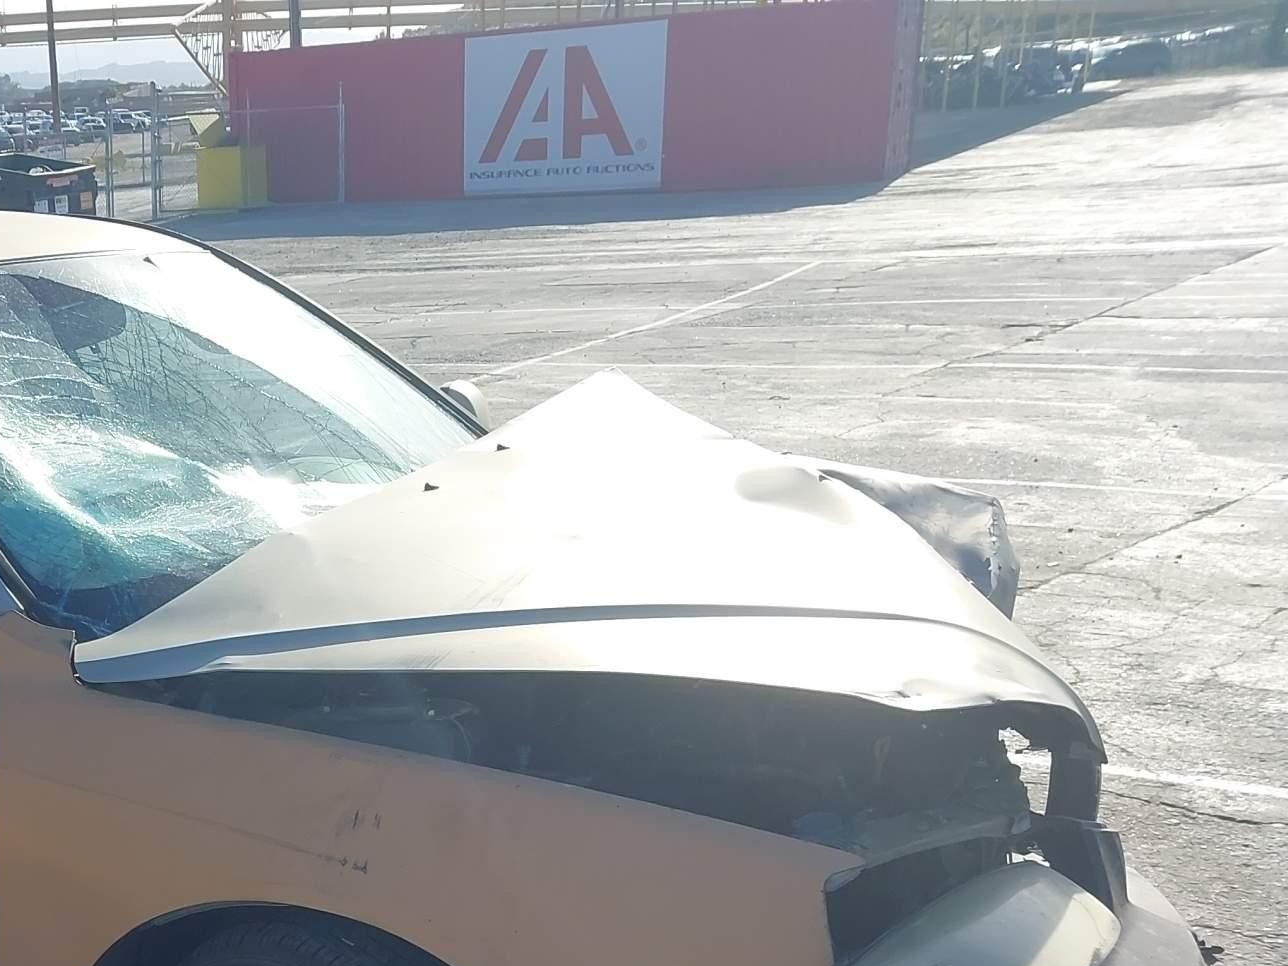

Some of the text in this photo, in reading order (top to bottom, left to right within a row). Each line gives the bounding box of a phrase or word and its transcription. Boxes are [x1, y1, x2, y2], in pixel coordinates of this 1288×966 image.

[469, 162, 656, 181] INSURANCE AUTO AUCTIONS
